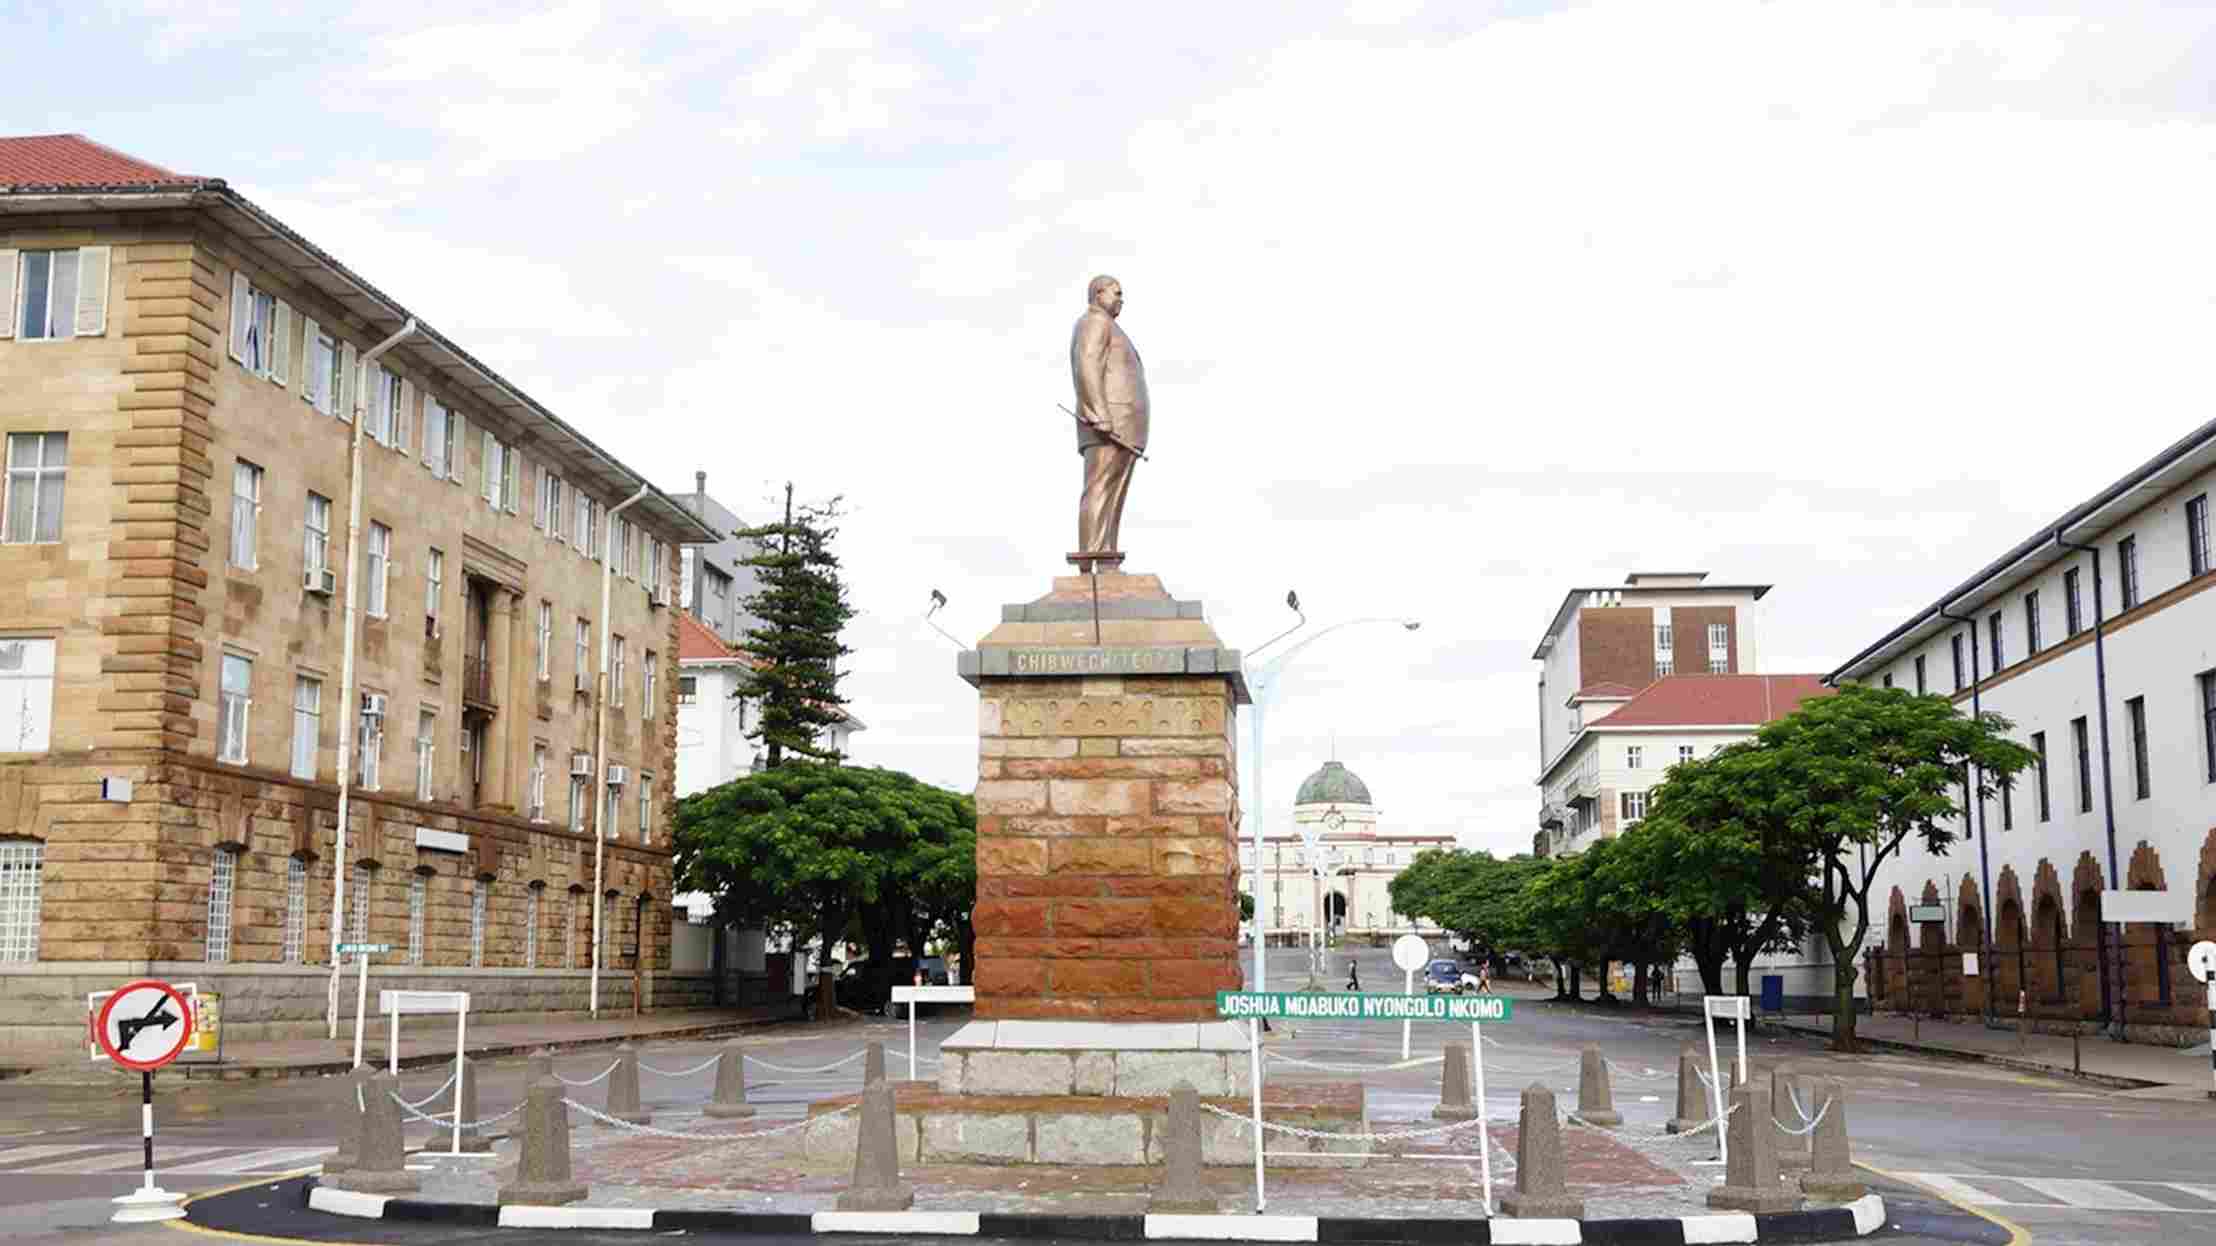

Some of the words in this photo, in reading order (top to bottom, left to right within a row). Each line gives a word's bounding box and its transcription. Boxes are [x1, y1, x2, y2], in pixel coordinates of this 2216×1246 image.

[1219, 994, 1280, 1016] JOSHUA
[1363, 997, 1446, 1018] NYONGOLO
[1448, 998, 1504, 1019] NKOMO
